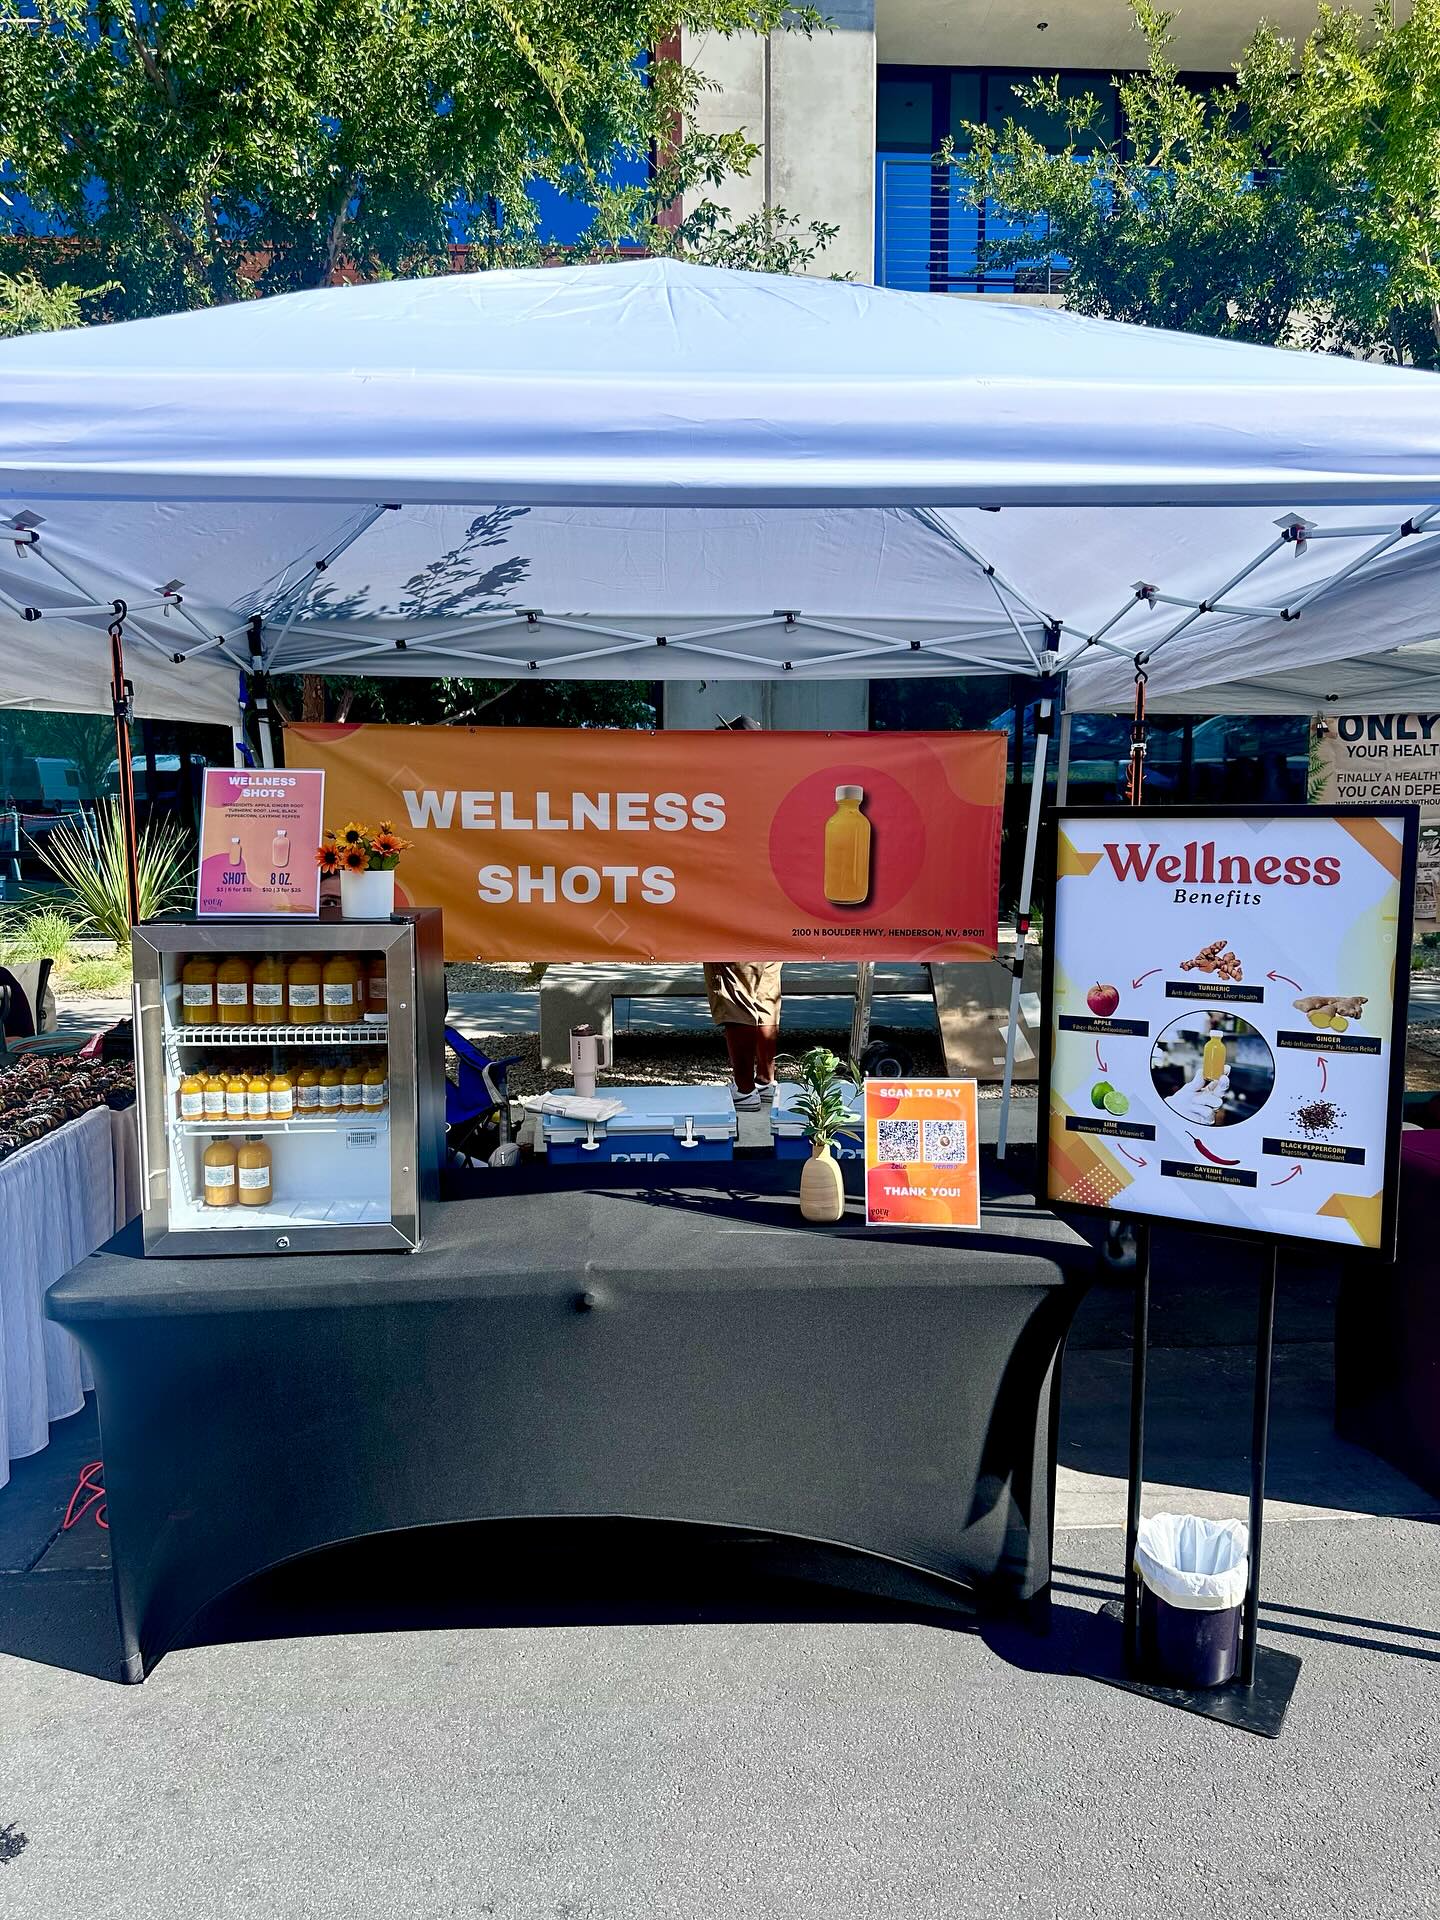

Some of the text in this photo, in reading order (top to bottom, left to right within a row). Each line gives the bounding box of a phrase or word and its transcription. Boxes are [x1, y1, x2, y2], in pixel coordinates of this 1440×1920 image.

[1338, 713, 1440, 741] ONLY
[1346, 743, 1440, 758] YOUR HEALT
[228, 776, 297, 786] WELLNESS
[1337, 772, 1382, 783] FINALLY
[1385, 773, 1392, 781] A
[242, 788, 286, 798] SHOTS
[1338, 784, 1440, 798] YOU CAN DEPE
[402, 790, 727, 832] WELLNESS
[1103, 841, 1341, 886] Wellness
[222, 872, 293, 886] SHOT 8 OZ.
[477, 865, 677, 904] SHOTS
[1173, 888, 1262, 908] Benefits
[791, 928, 985, 938] 2100 N BOULDER HWY, HENDERSON, NV, 89011
[1198, 984, 1231, 992] TURMERIC
[1316, 1035, 1341, 1043] GINGER
[1359, 1045, 1377, 1053] Relief
[879, 1088, 961, 1098] SCAN TO PAY
[1078, 1125, 1102, 1133] Immunity
[1103, 1121, 1118, 1129] LIME
[1280, 1141, 1346, 1155] BLACK PEPPERCORN
[1311, 1151, 1345, 1161] Antioxidant
[1194, 1166, 1223, 1175] CAYENNE
[1205, 1173, 1221, 1181] Heart
[1222, 1176, 1241, 1184] Health
[883, 1186, 961, 1197] THANK YOU!
